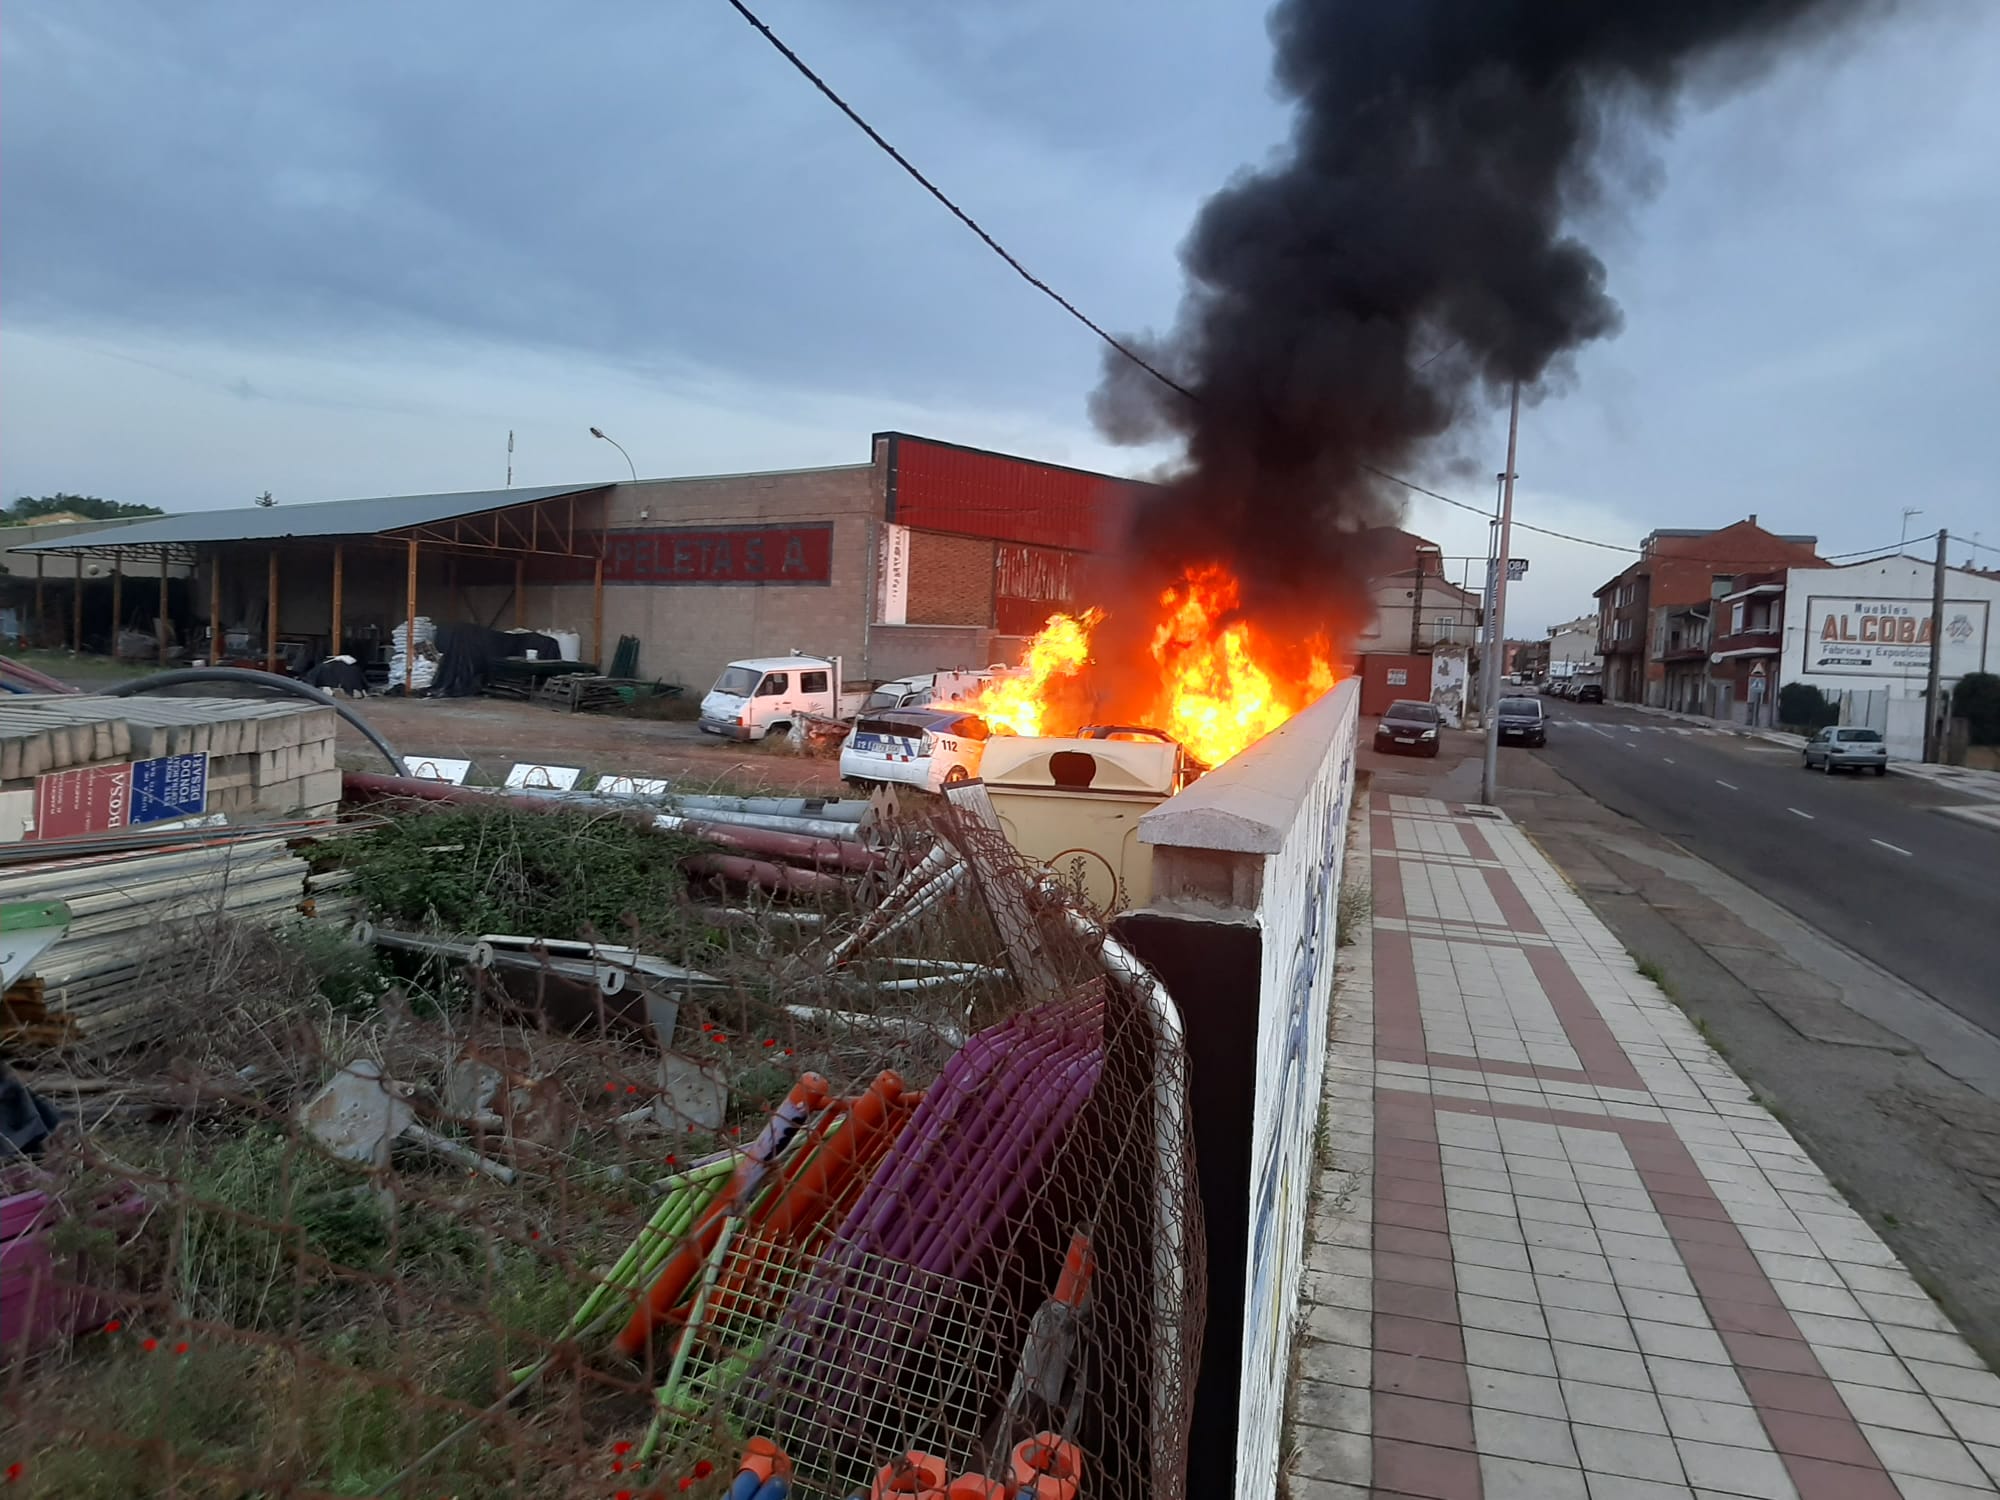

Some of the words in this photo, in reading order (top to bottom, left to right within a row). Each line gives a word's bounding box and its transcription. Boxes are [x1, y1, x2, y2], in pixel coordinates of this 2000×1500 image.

[1508, 560, 1527, 570] OBA
[1855, 603, 1908, 615] Muebles
[1820, 614, 1933, 643] ALCOBA
[1866, 648, 1872, 658] y
[941, 739, 958, 752] 112
[179, 759, 191, 804] FONDO
